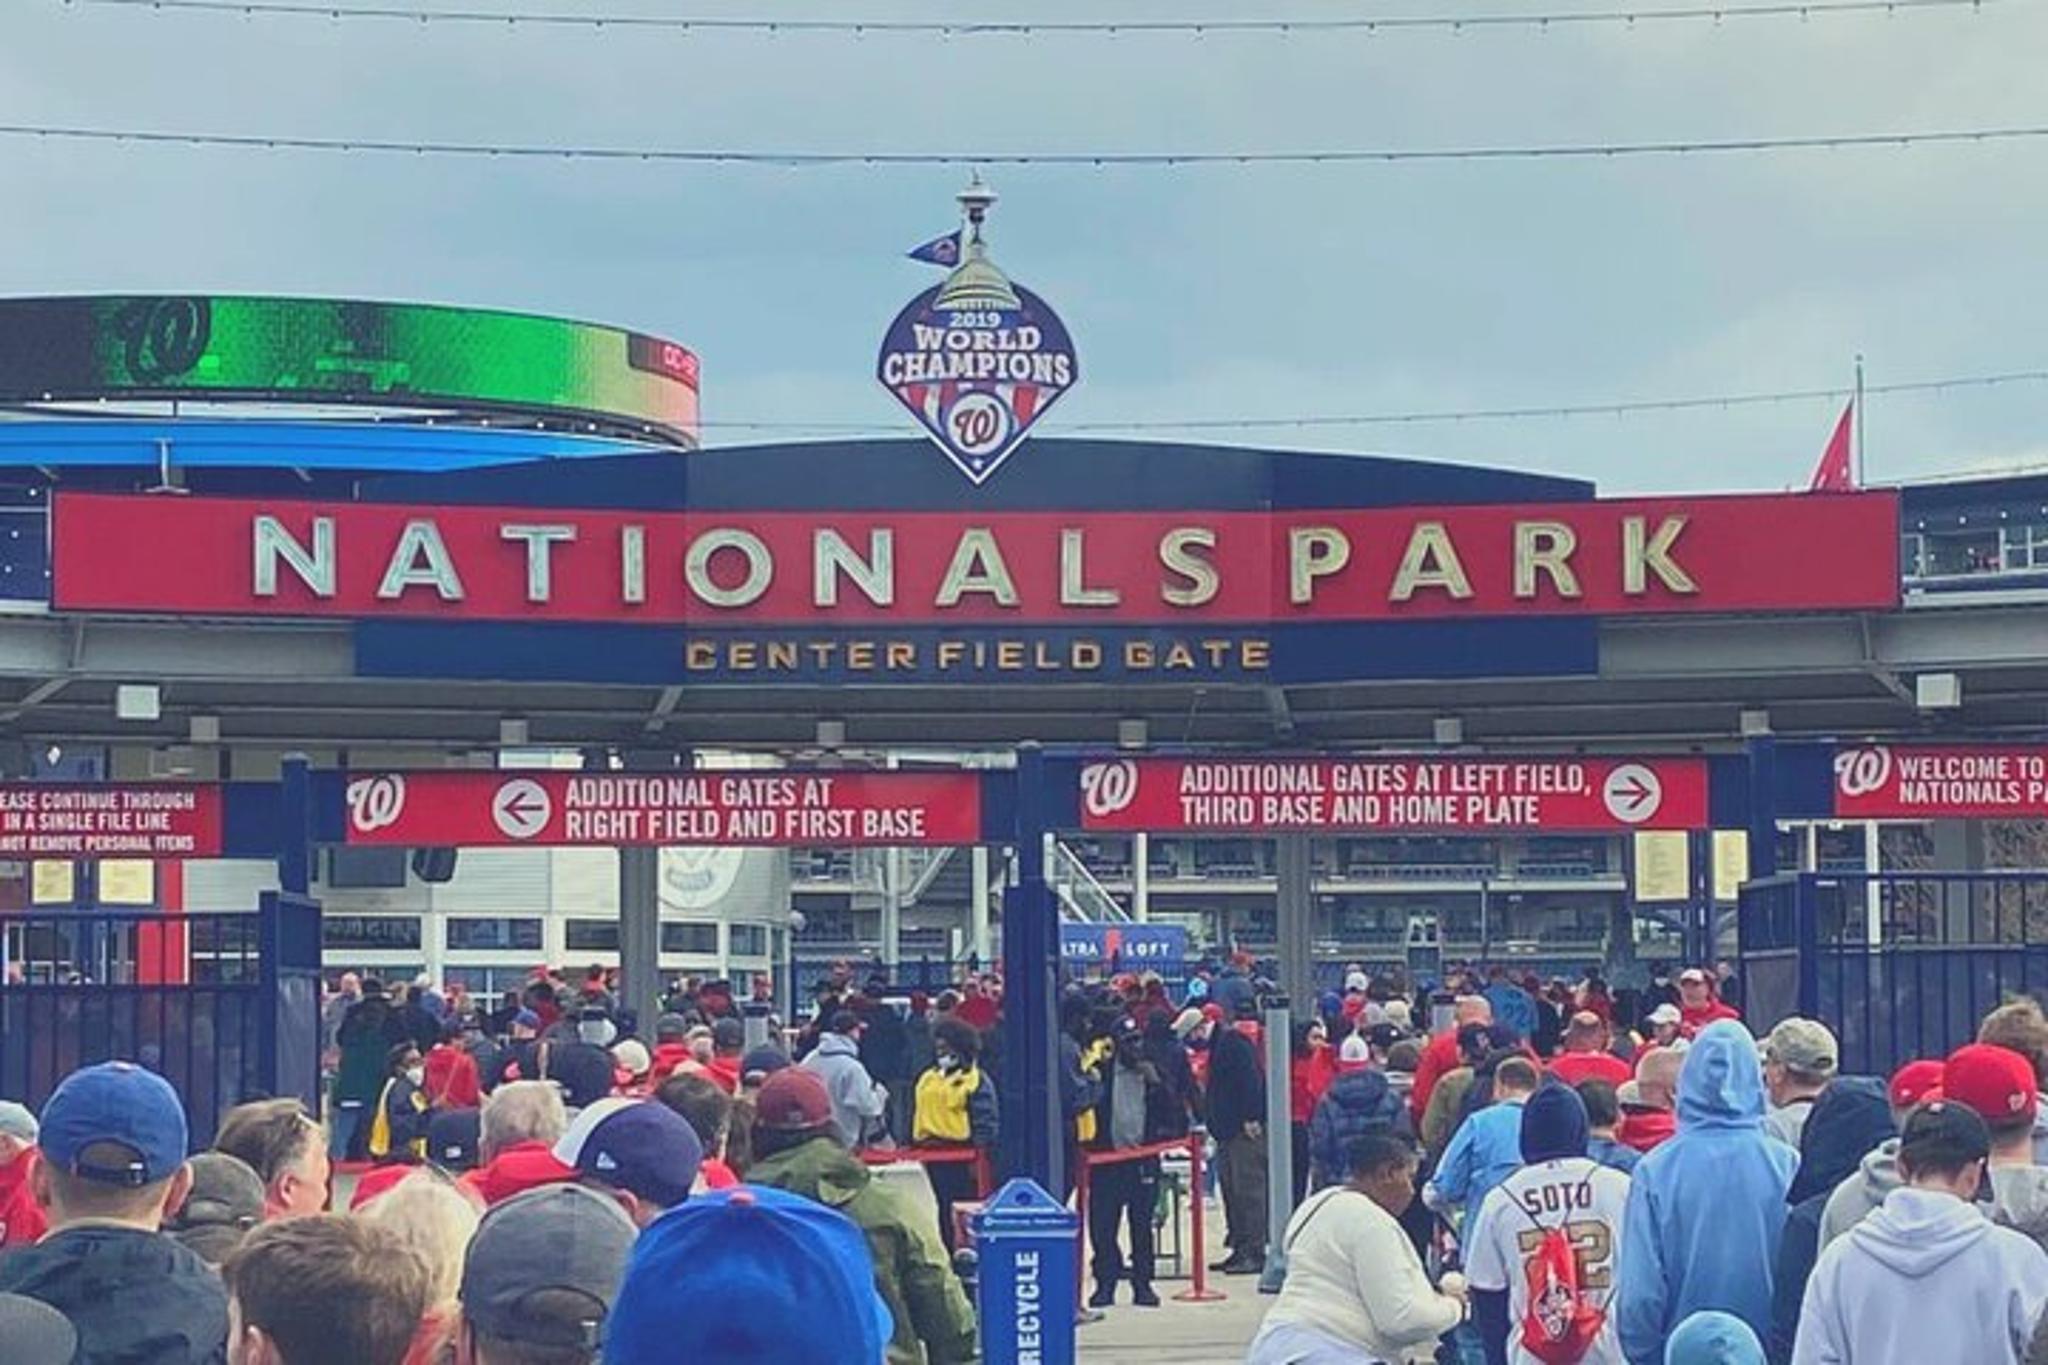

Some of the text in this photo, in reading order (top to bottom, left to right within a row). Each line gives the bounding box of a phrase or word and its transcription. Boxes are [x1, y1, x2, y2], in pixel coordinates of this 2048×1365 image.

[950, 312, 1000, 327] 2019
[913, 324, 1042, 351] WORLD
[884, 351, 1071, 386] CHAMPIONS
[251, 514, 1699, 608] NATIONALS PARK
[686, 641, 1270, 670] CENTER FIELD GATE
[1180, 764, 1592, 796] ADDITIONAL GATES AT LEFT FIELD,
[1899, 755, 2045, 781] WELCOME TO
[41, 792, 118, 811] CONTINUE
[122, 792, 195, 809] THROUGH
[565, 778, 833, 807] ADDITIONAL GATES AT
[1899, 780, 2020, 804] NATIONALS
[4, 812, 171, 831] IN A SINGLE FILE LINE
[1180, 796, 1540, 824] THIRD BASE AND HOME PLATE
[565, 809, 926, 840] RIGHT FIELD AND FIRST BASE
[29, 835, 83, 851] REMOVE
[86, 835, 152, 851] PERSONAL
[155, 835, 195, 851] ITEMS
[1126, 942, 1170, 957] LOFT
[1523, 1182, 1592, 1216] SOTO
[1015, 1251, 1041, 1365] RECYCLE
